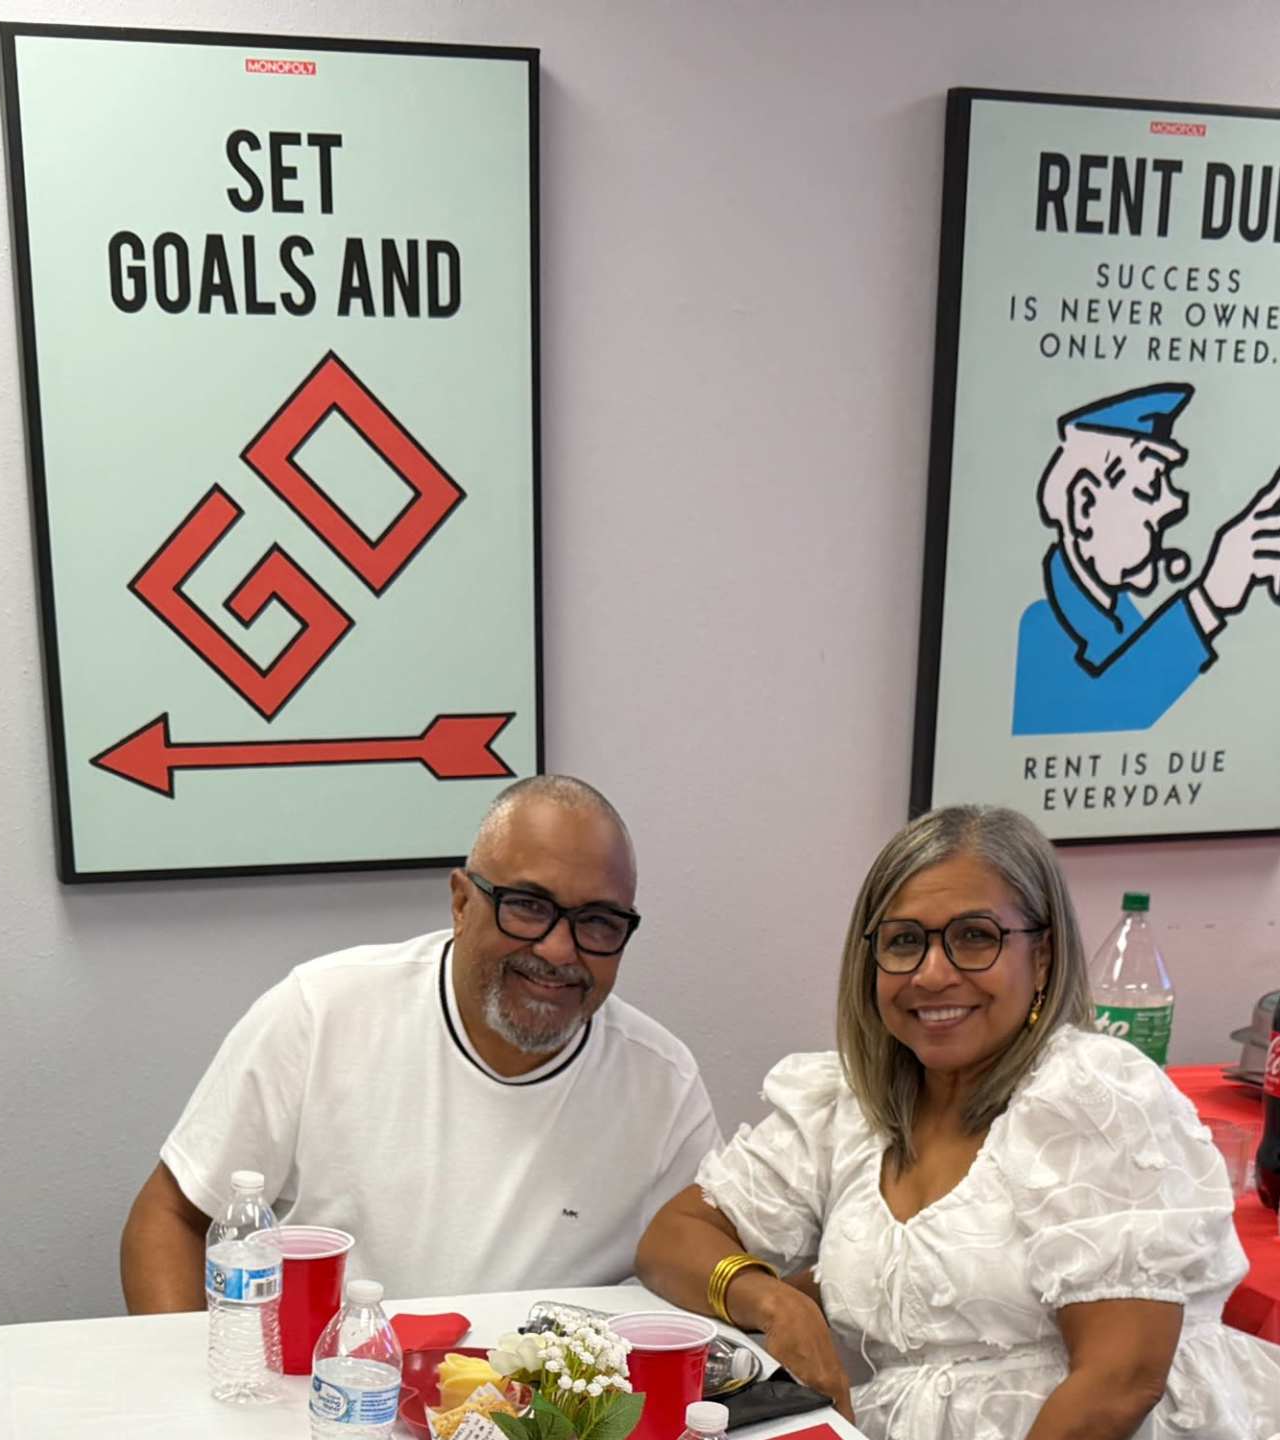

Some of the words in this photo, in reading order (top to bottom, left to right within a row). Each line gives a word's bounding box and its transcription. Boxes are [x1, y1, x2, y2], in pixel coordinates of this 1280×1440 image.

[247, 60, 315, 75] MONOPOLY
[1152, 122, 1206, 136] MONOPOLY
[225, 129, 343, 215] SET
[1035, 151, 1184, 238] RENT
[108, 230, 317, 317] GOALS
[337, 237, 462, 319] AND
[1096, 262, 1241, 294] SUCCESS
[1010, 295, 1038, 322] IS
[1061, 298, 1163, 327] NEVER
[1039, 332, 1127, 359] ONLY
[1147, 336, 1278, 364] RENTED.
[126, 349, 467, 723] GO
[1024, 754, 1102, 780] RENT
[1121, 752, 1148, 777] IS
[1168, 750, 1226, 774] DUE
[1043, 783, 1203, 812] EVERYDAY
